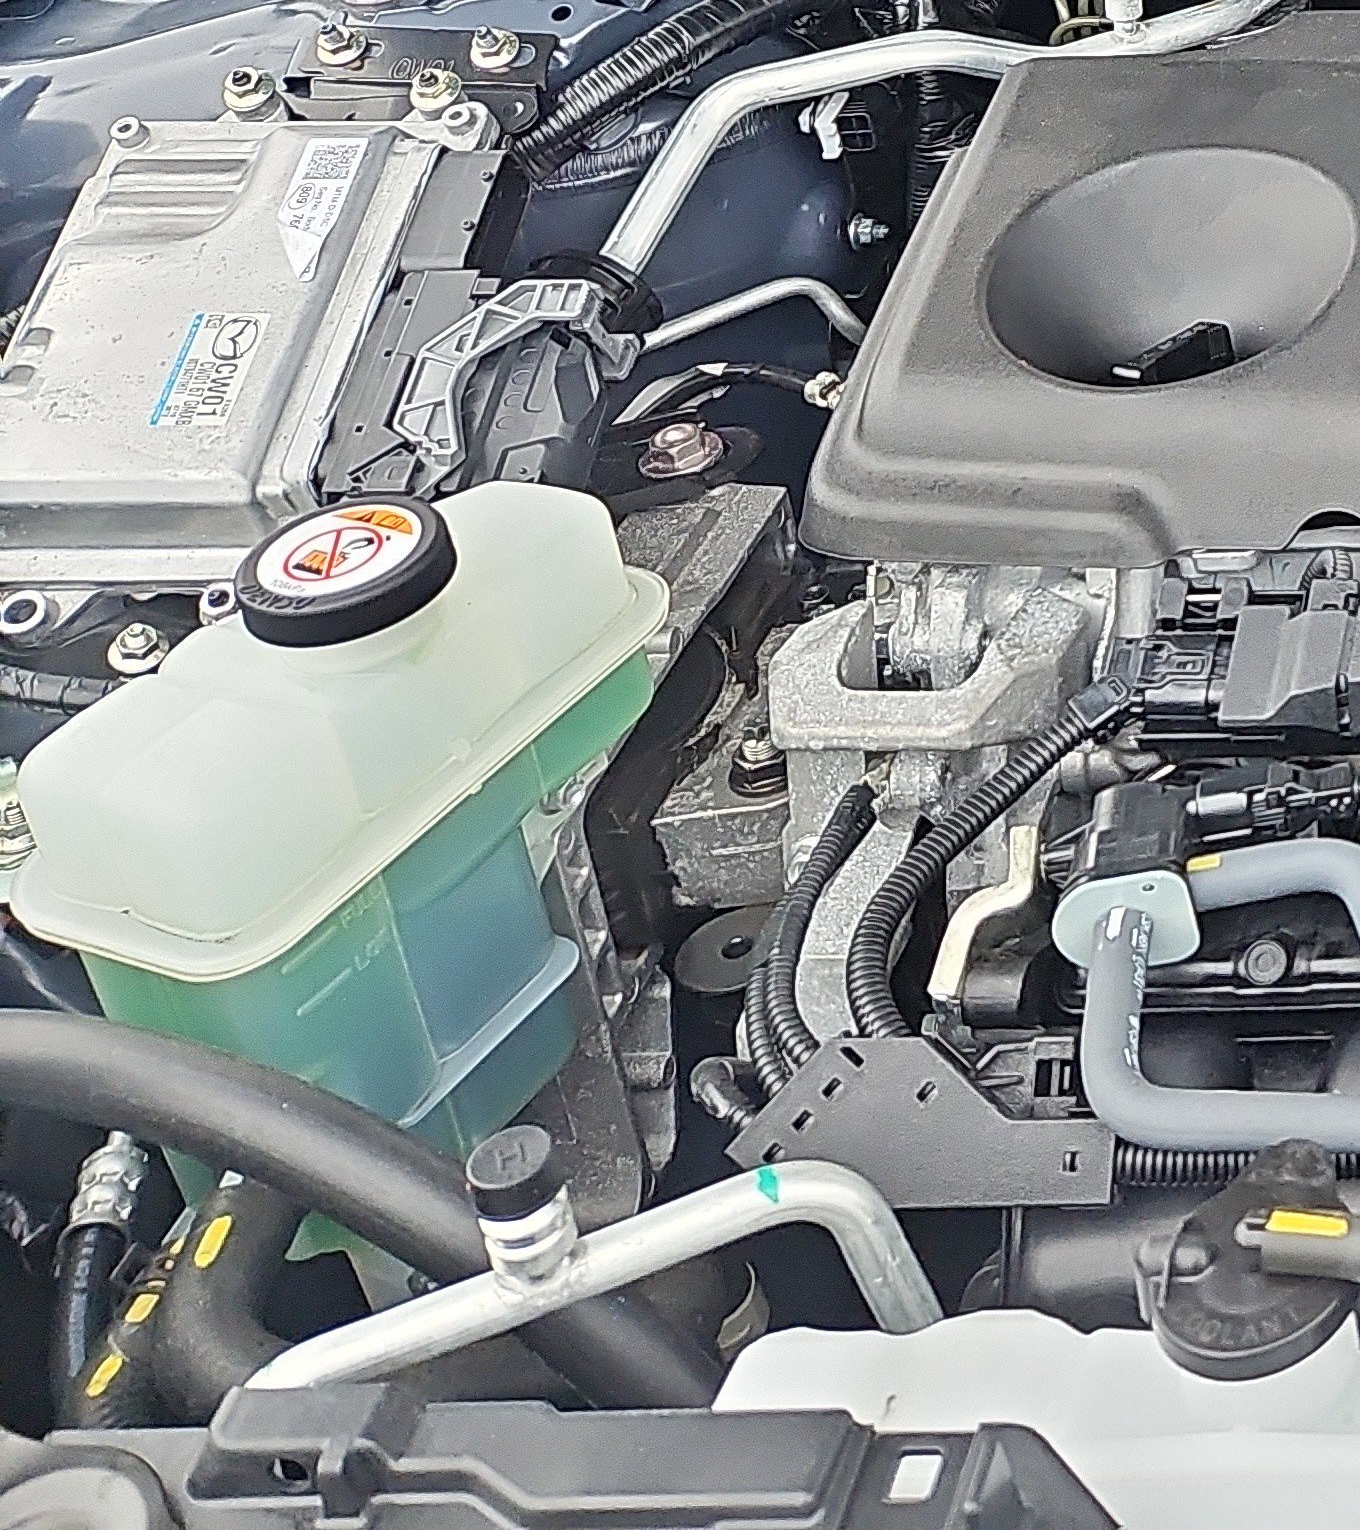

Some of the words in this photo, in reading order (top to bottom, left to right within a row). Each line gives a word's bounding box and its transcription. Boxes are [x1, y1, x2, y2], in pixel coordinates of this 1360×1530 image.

[296, 186, 312, 204] 809
[192, 361, 216, 385] CW01
[196, 363, 238, 416] CW01
